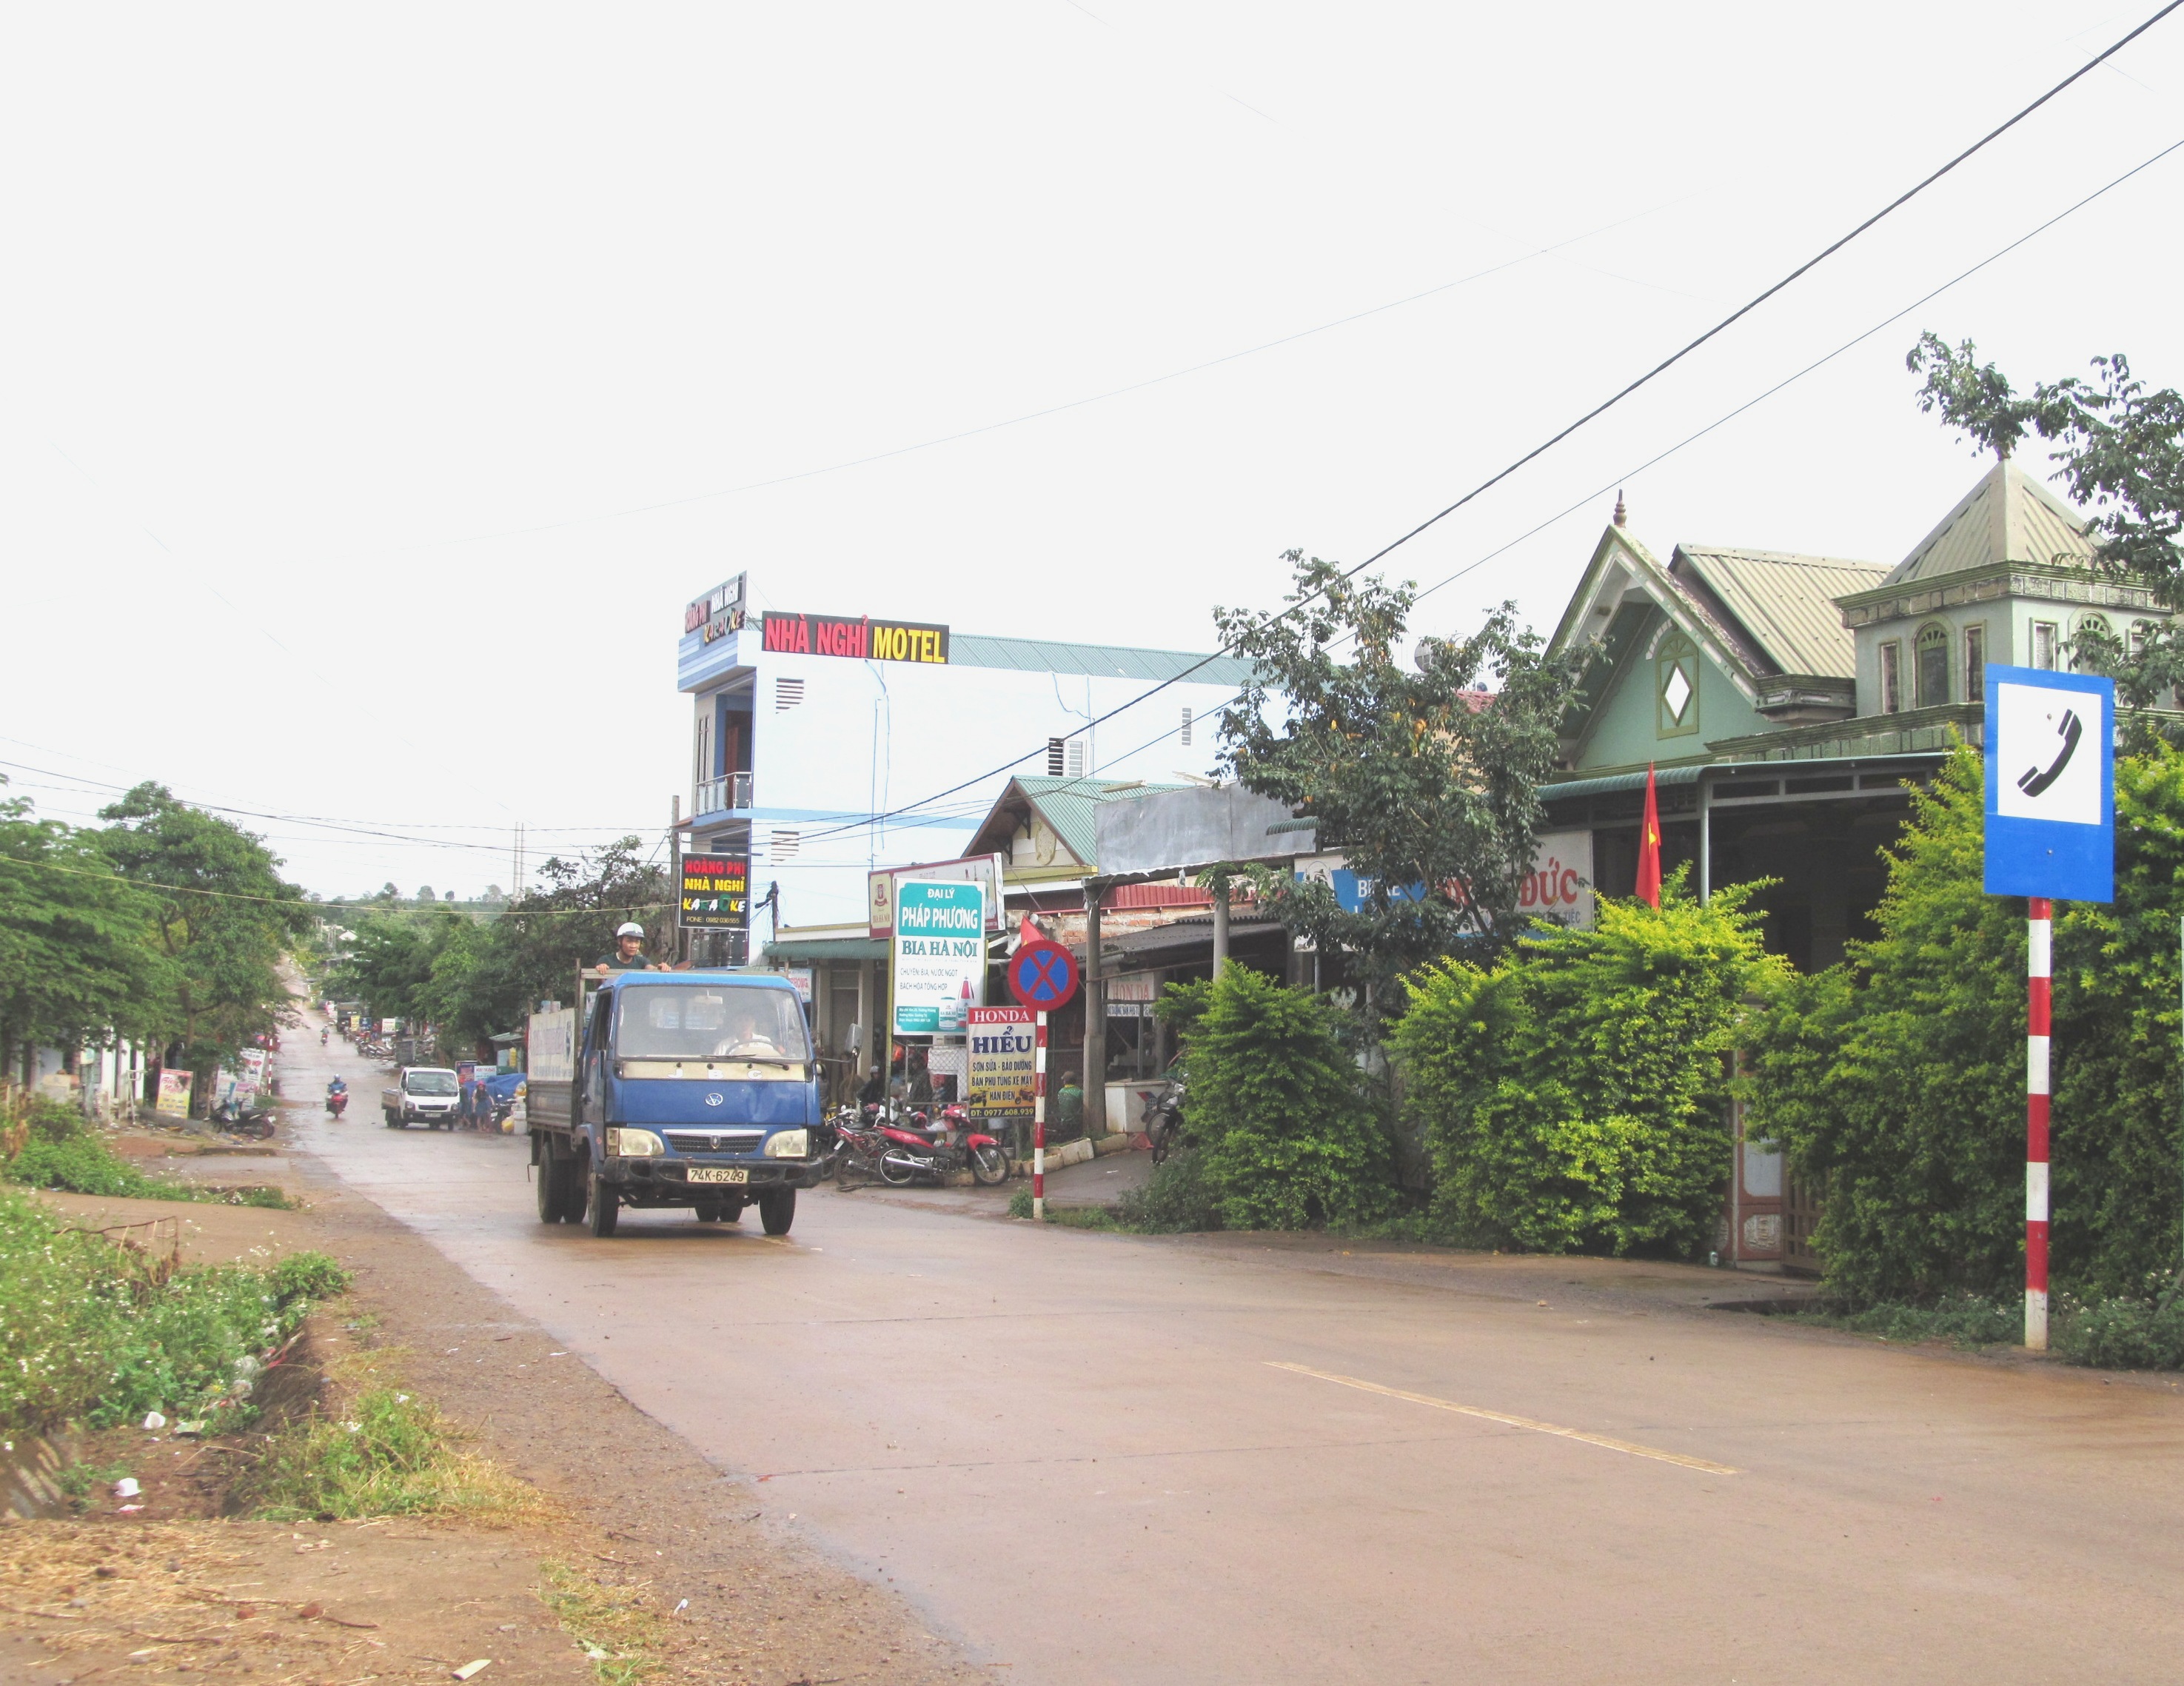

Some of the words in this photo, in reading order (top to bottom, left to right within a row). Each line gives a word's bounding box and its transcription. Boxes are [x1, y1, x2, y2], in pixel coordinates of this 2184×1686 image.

[765, 613, 811, 653] NHÀ
[817, 615, 869, 658] NGHỈ
[873, 626, 945, 663] MOTEL
[686, 857, 724, 874] HOÀNG
[727, 861, 746, 875] PHI
[684, 876, 710, 891] NHÀ
[714, 876, 746, 891] NGHỈ
[1520, 857, 1578, 906] ĐỨC
[927, 889, 943, 900] ĐẠI
[945, 887, 955, 899] LÝ
[683, 894, 746, 912] KARAOKE
[902, 903, 931, 928] PHÁP
[932, 906, 978, 929] PHƯƠNG
[902, 940, 927, 955] BIA
[929, 939, 950, 956] HÀ
[953, 940, 978, 958] NỘI
[974, 1010, 1030, 1023] HONDA
[972, 1026, 1032, 1054] HIỂU
[1013, 1076, 1019, 1085] XE
[984, 1108, 1034, 1117] 0977.608.939
[691, 1170, 744, 1182] 74K-6249
